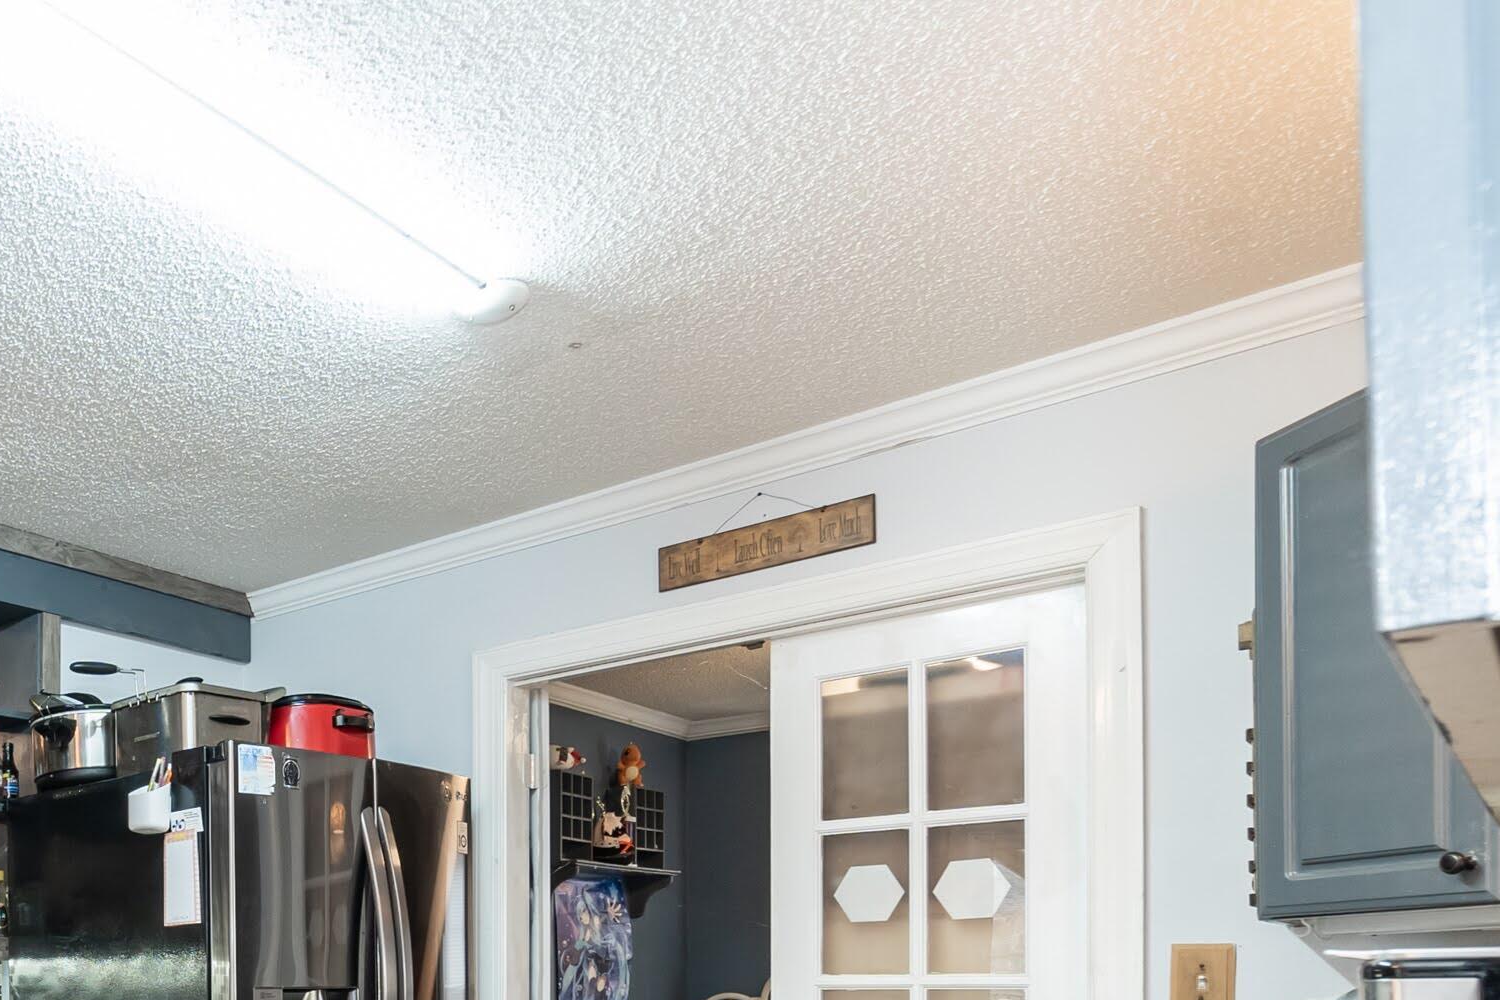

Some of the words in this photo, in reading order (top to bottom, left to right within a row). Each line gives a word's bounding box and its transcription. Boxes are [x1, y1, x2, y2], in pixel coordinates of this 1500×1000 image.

[734, 532, 759, 564] Laugh
[759, 529, 784, 557] Often
[819, 517, 837, 543] Love
[838, 506, 862, 537] Much
